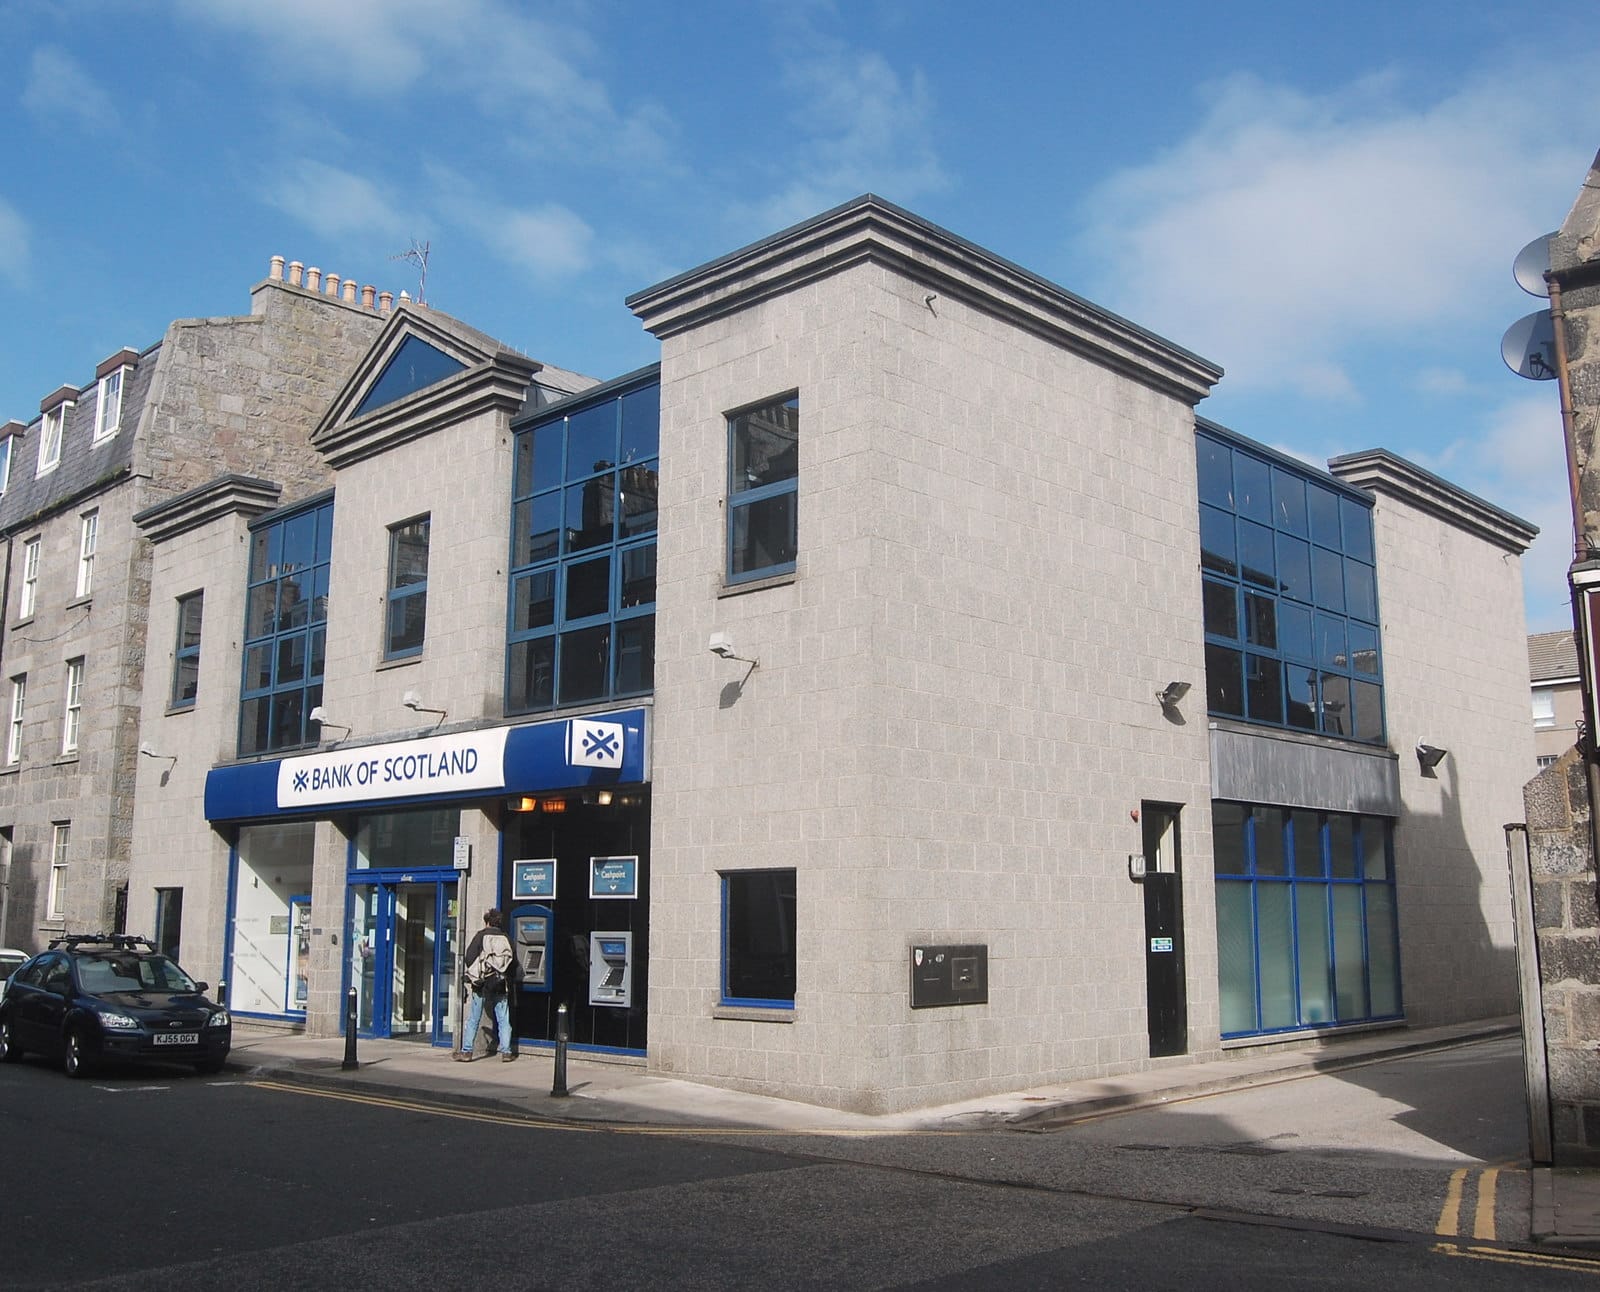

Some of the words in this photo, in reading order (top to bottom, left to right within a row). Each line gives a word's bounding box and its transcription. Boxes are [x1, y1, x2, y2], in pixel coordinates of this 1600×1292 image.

[312, 763, 352, 790] BANK
[357, 760, 378, 785] OF
[384, 748, 478, 782] SCOTLAND
[523, 872, 546, 882] Cashpoint
[601, 870, 626, 880] Cashpoint
